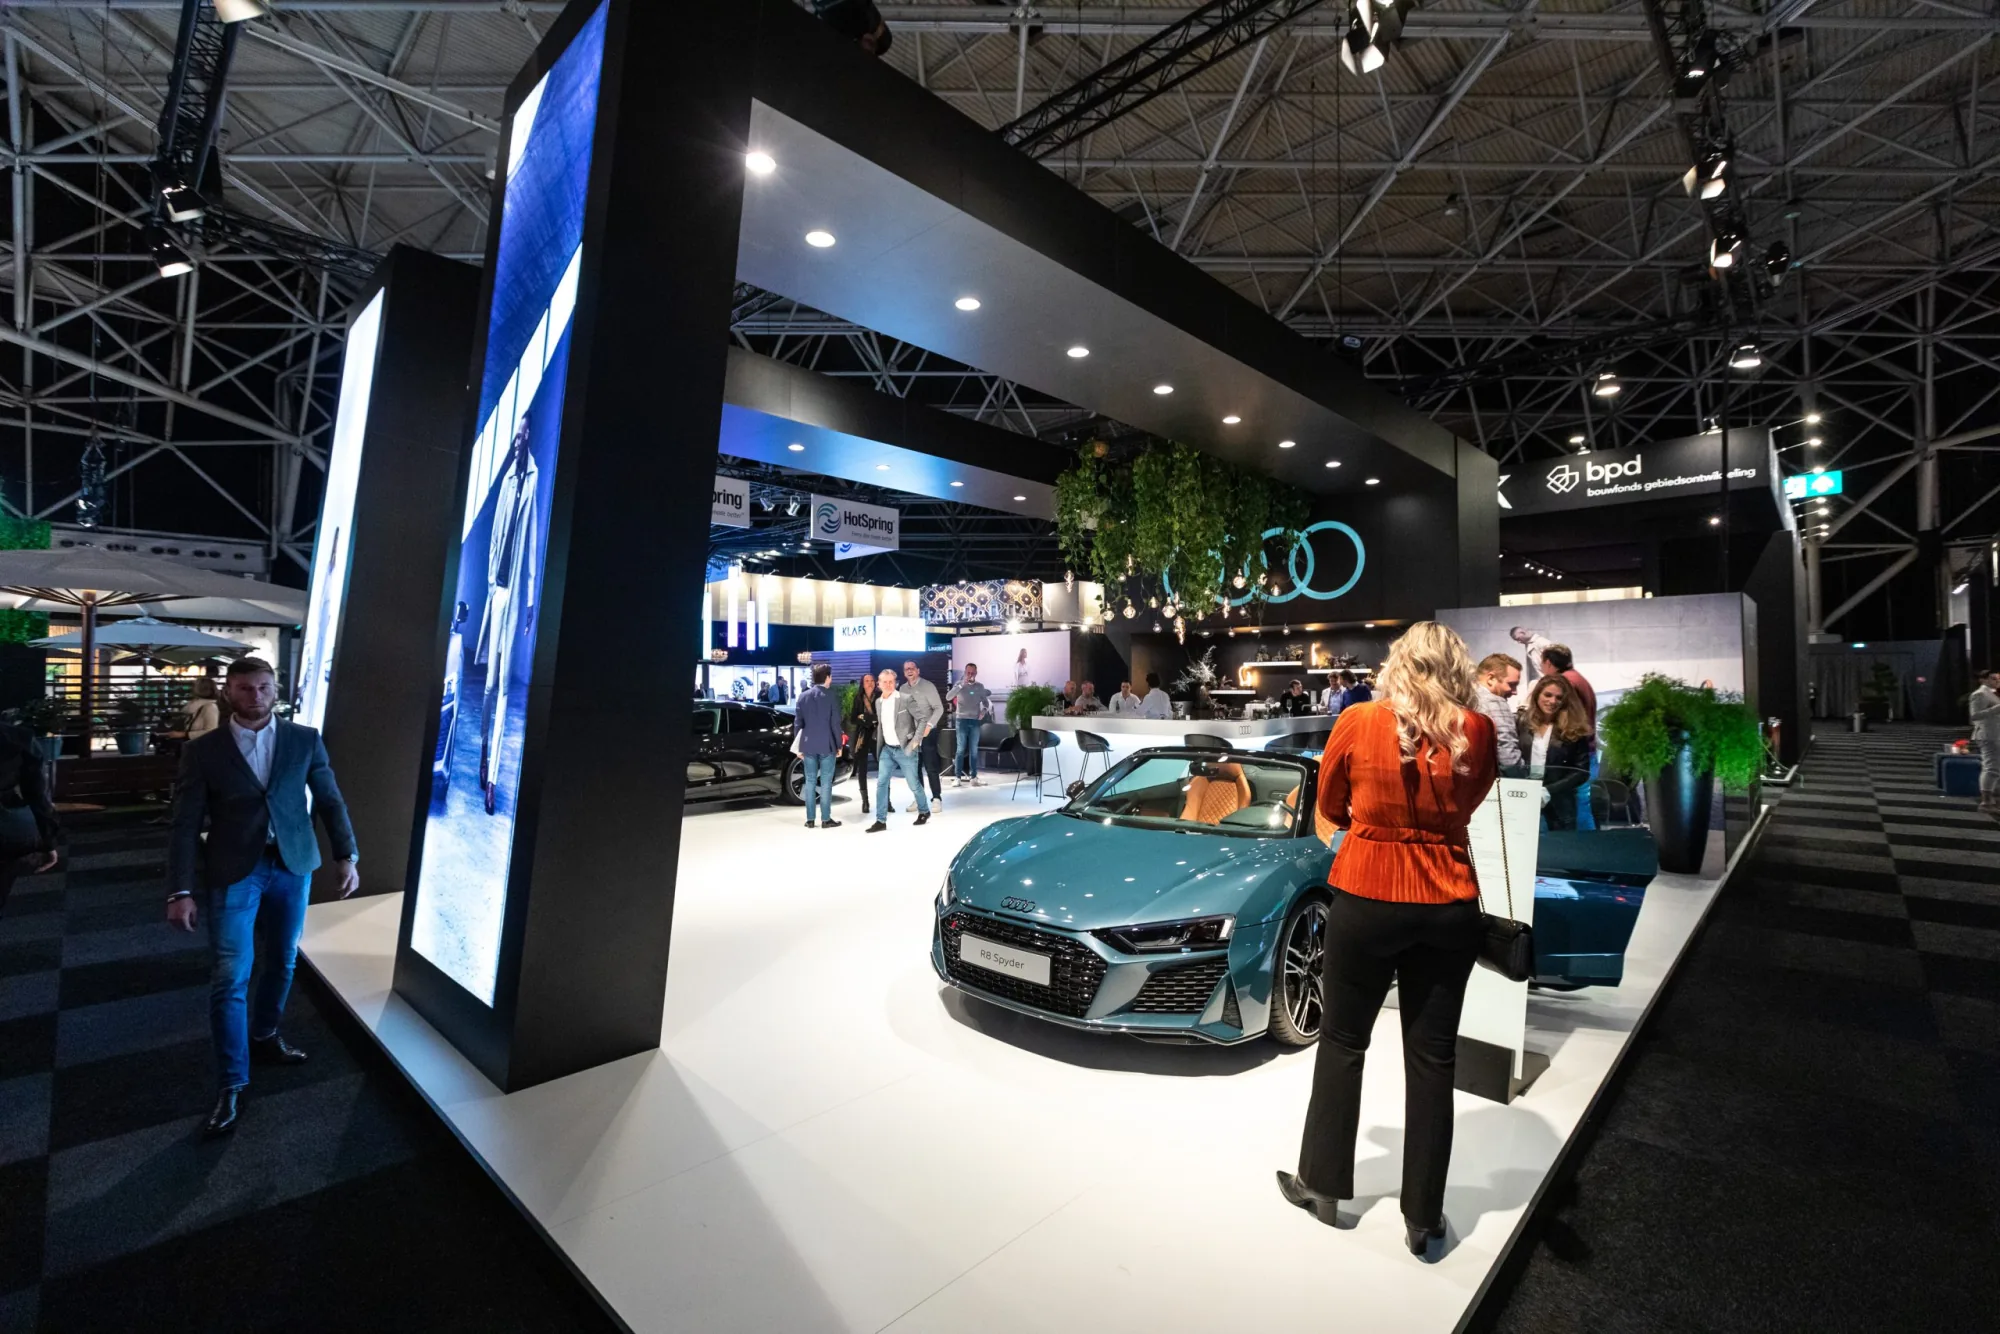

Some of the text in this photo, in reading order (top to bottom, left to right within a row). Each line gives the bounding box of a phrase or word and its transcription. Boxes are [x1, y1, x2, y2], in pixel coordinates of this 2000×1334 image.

[1585, 454, 1642, 484] bpd
[1586, 468, 1756, 497] bouwfonds gebiedsontwikeling
[843, 511, 894, 534] HotSpring
[842, 625, 867, 637] KLAFS
[980, 949, 1025, 970] R8 Spyder
